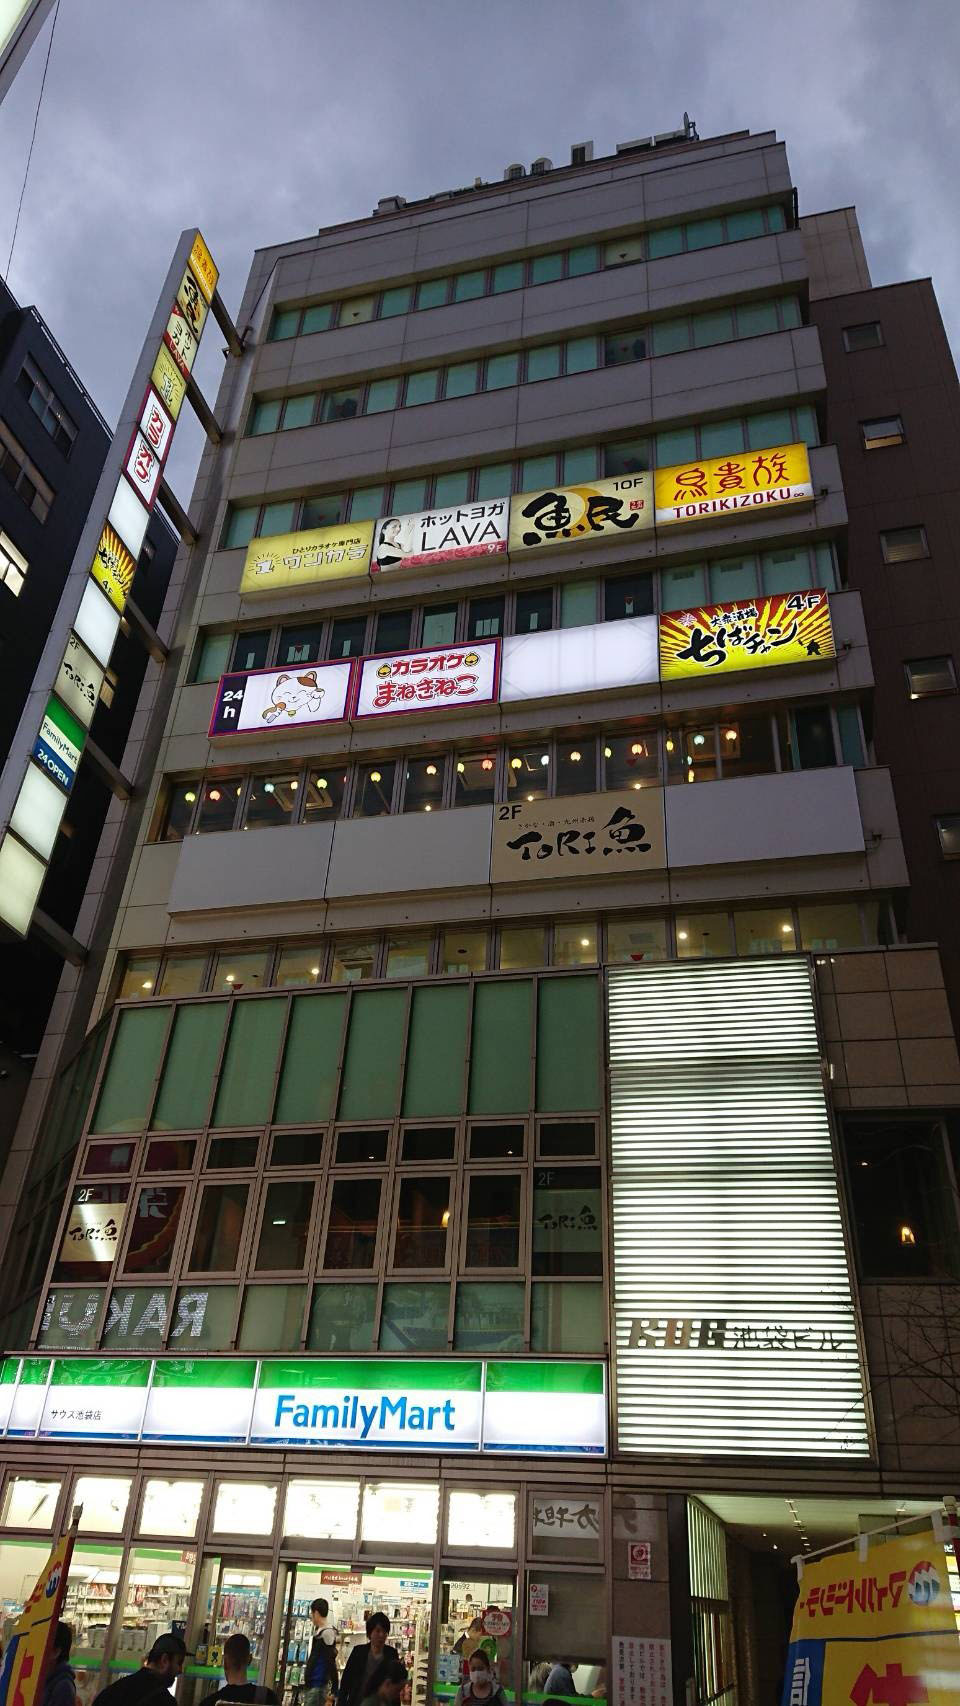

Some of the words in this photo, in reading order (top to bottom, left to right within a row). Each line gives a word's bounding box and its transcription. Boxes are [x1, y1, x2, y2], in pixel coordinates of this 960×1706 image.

[612, 477, 644, 491] 10F
[673, 453, 790, 501] 鳥貴族
[672, 487, 791, 519] TORIKIZOKU
[420, 502, 506, 529] ホットヨガ
[521, 492, 640, 547] 魚民
[421, 520, 502, 552] LAVA
[282, 543, 369, 570] ワンカラ
[487, 543, 504, 554] 9F
[786, 595, 820, 611] 4F
[710, 607, 759, 628] 大衆酒場
[70, 637, 80, 650] 2F
[676, 619, 799, 668] ちばチャン
[391, 653, 465, 677] カラオケ
[223, 689, 244, 702] 24
[373, 674, 479, 708] まねきねこ
[223, 705, 236, 719] h
[42, 721, 78, 766] FamilyMart
[498, 804, 523, 821] 2F
[538, 1171, 557, 1186] 2F
[77, 1188, 95, 1202] 2F
[50, 1409, 104, 1422] サウス池袋店
[274, 1394, 456, 1440] FamilyMart
